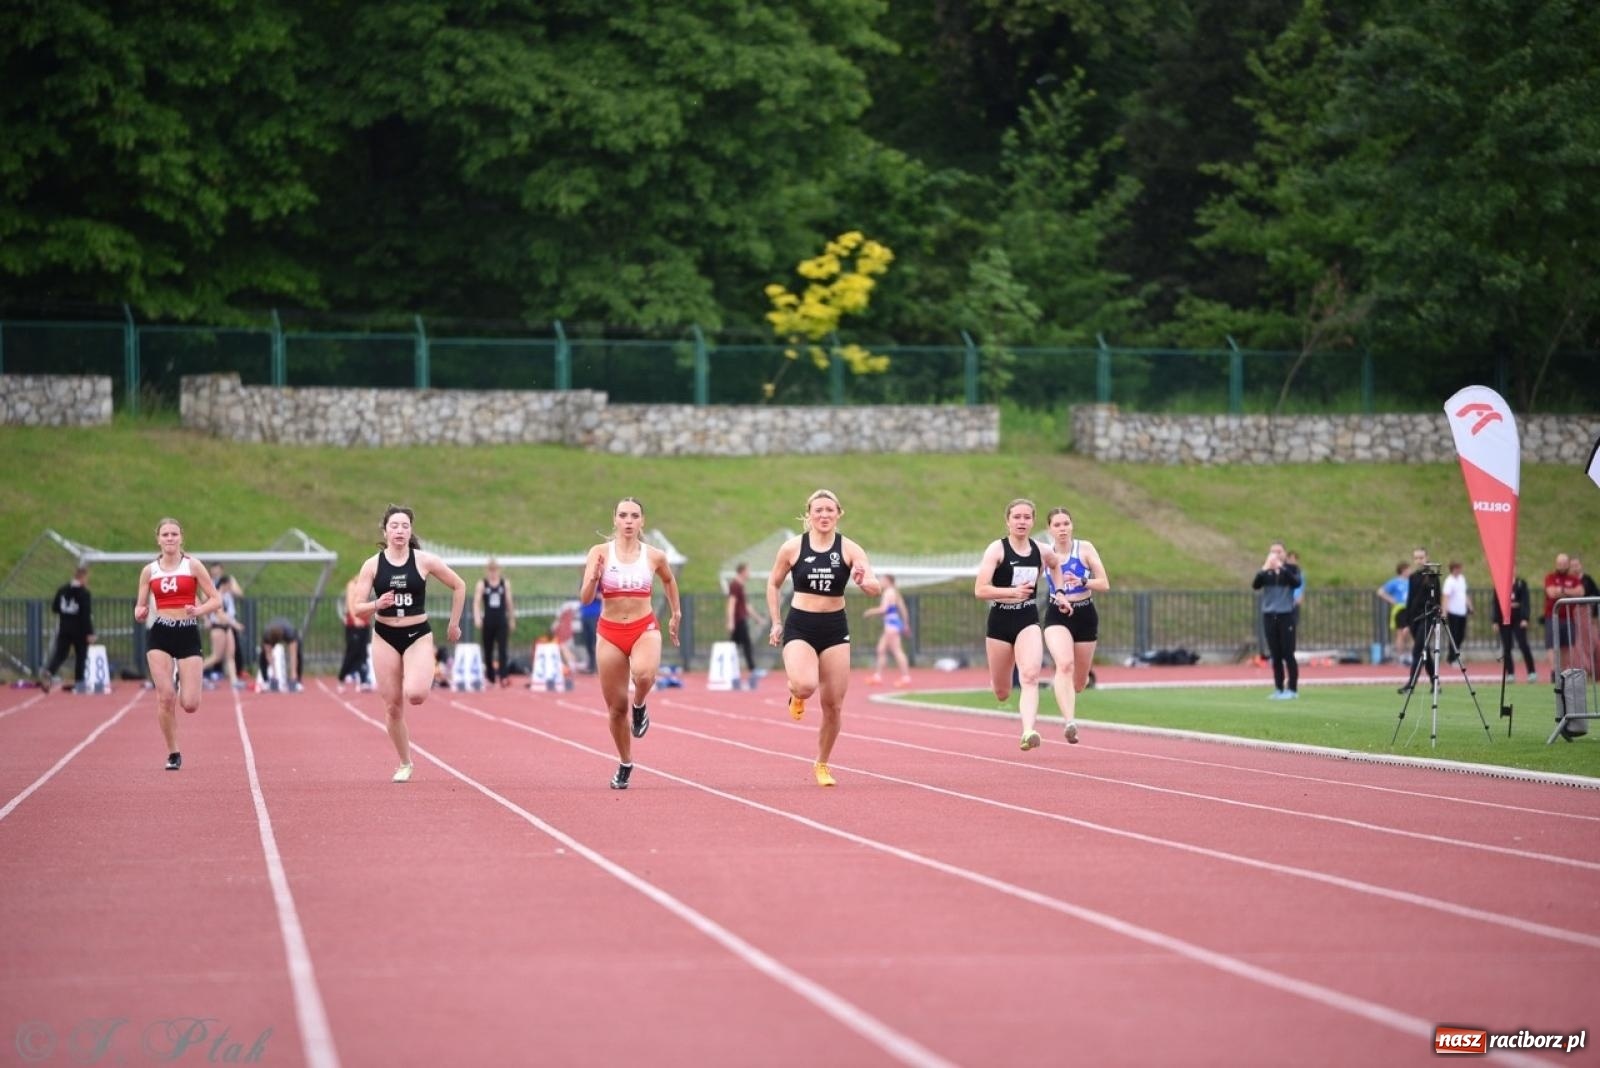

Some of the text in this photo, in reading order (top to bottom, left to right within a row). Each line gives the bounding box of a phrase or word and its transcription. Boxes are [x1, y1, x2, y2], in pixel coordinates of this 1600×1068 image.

[161, 577, 178, 593] 64
[810, 580, 832, 592] 412
[394, 593, 413, 606] 08
